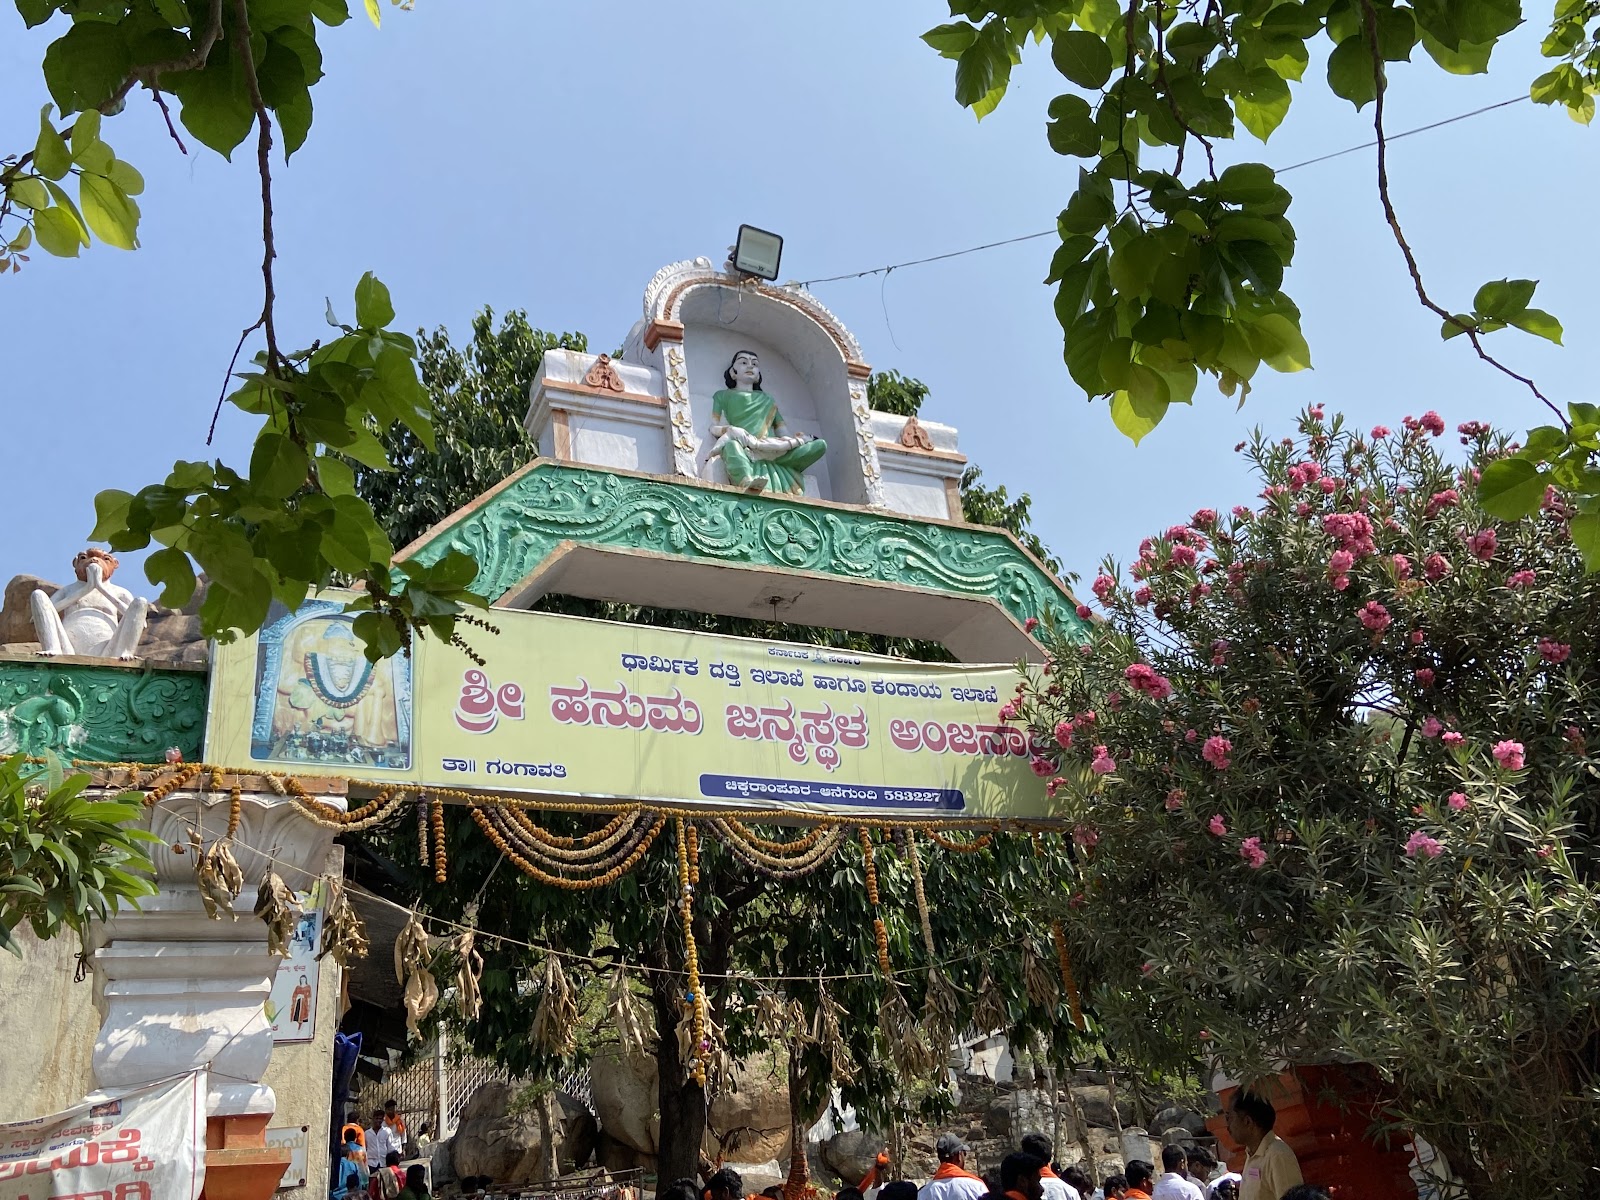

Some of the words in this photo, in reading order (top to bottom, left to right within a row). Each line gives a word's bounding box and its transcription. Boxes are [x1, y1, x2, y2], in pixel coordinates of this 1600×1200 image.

[621, 653, 699, 676] ಧಾರ್ಮಿಕ
[708, 660, 741, 687] ದತ್ತಿ
[749, 668, 804, 688] ಇಲಾಖೆ
[812, 674, 867, 693] ಹಾಗೂ
[870, 678, 942, 700] ಕಂದಾಯ
[949, 685, 999, 703] ಇಲಾಖೆ
[454, 668, 525, 734] ಶ್ರೀ
[549, 677, 704, 735] ಹನುಮ
[724, 697, 869, 771] ಜನ್ಮಸ್ಥಳ
[486, 758, 568, 778] ಗಂಗಾವತಿ
[884, 789, 942, 803] 583227
